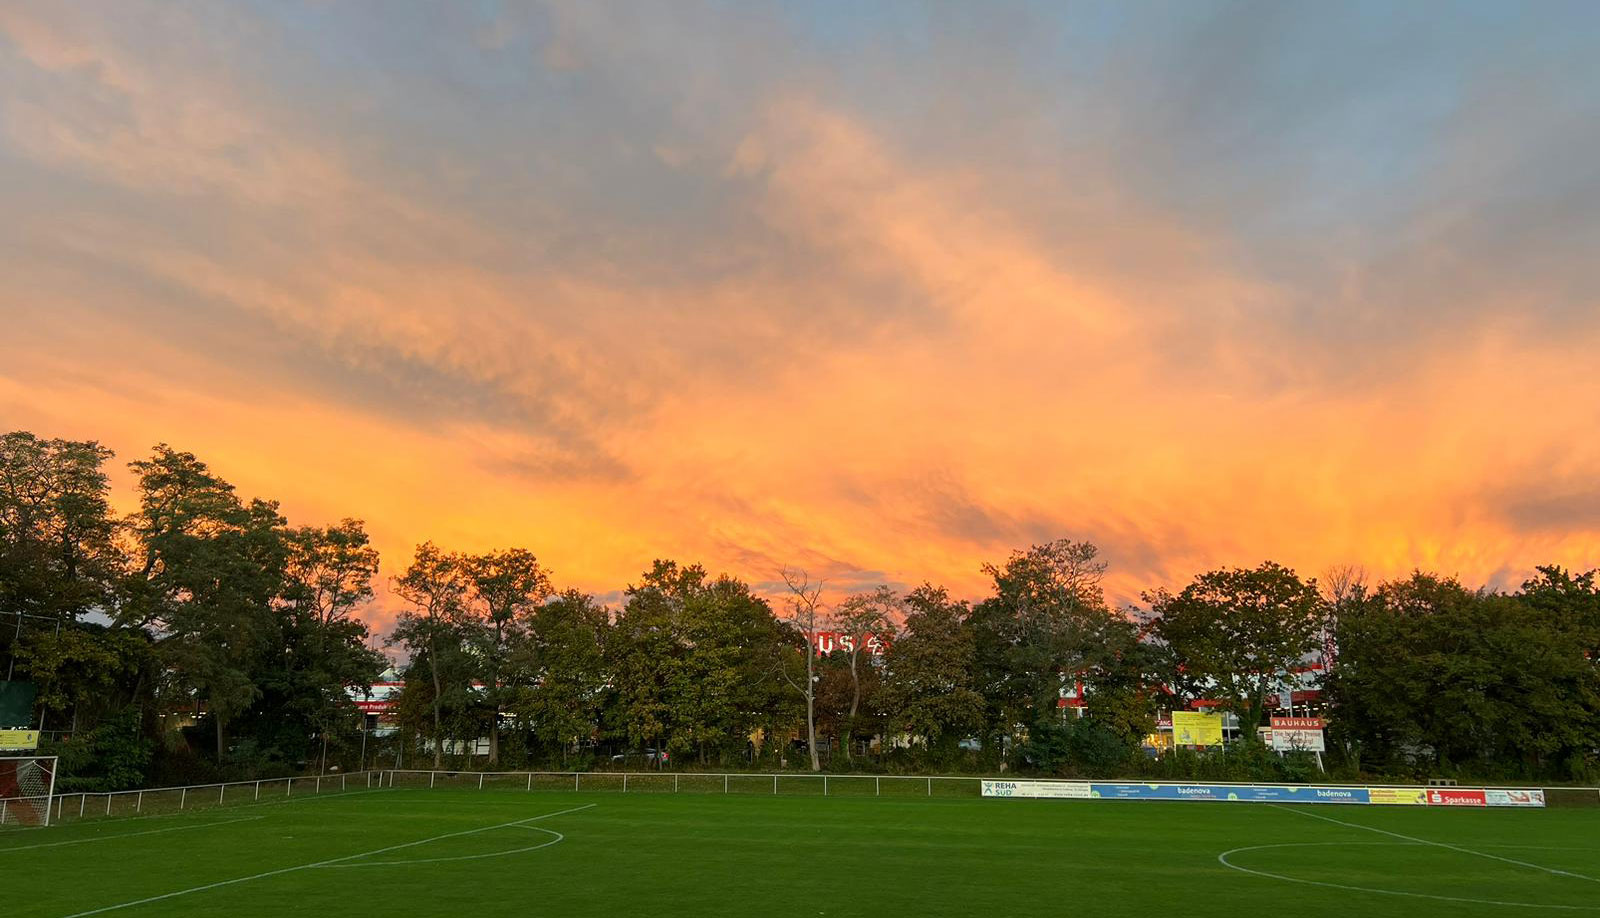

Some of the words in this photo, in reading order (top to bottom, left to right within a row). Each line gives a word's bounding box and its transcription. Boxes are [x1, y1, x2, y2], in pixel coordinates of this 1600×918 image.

[1274, 719, 1320, 727] BAUHAUS
[1177, 786, 1211, 794] badenova
[1444, 796, 1482, 805] Sparkasse
